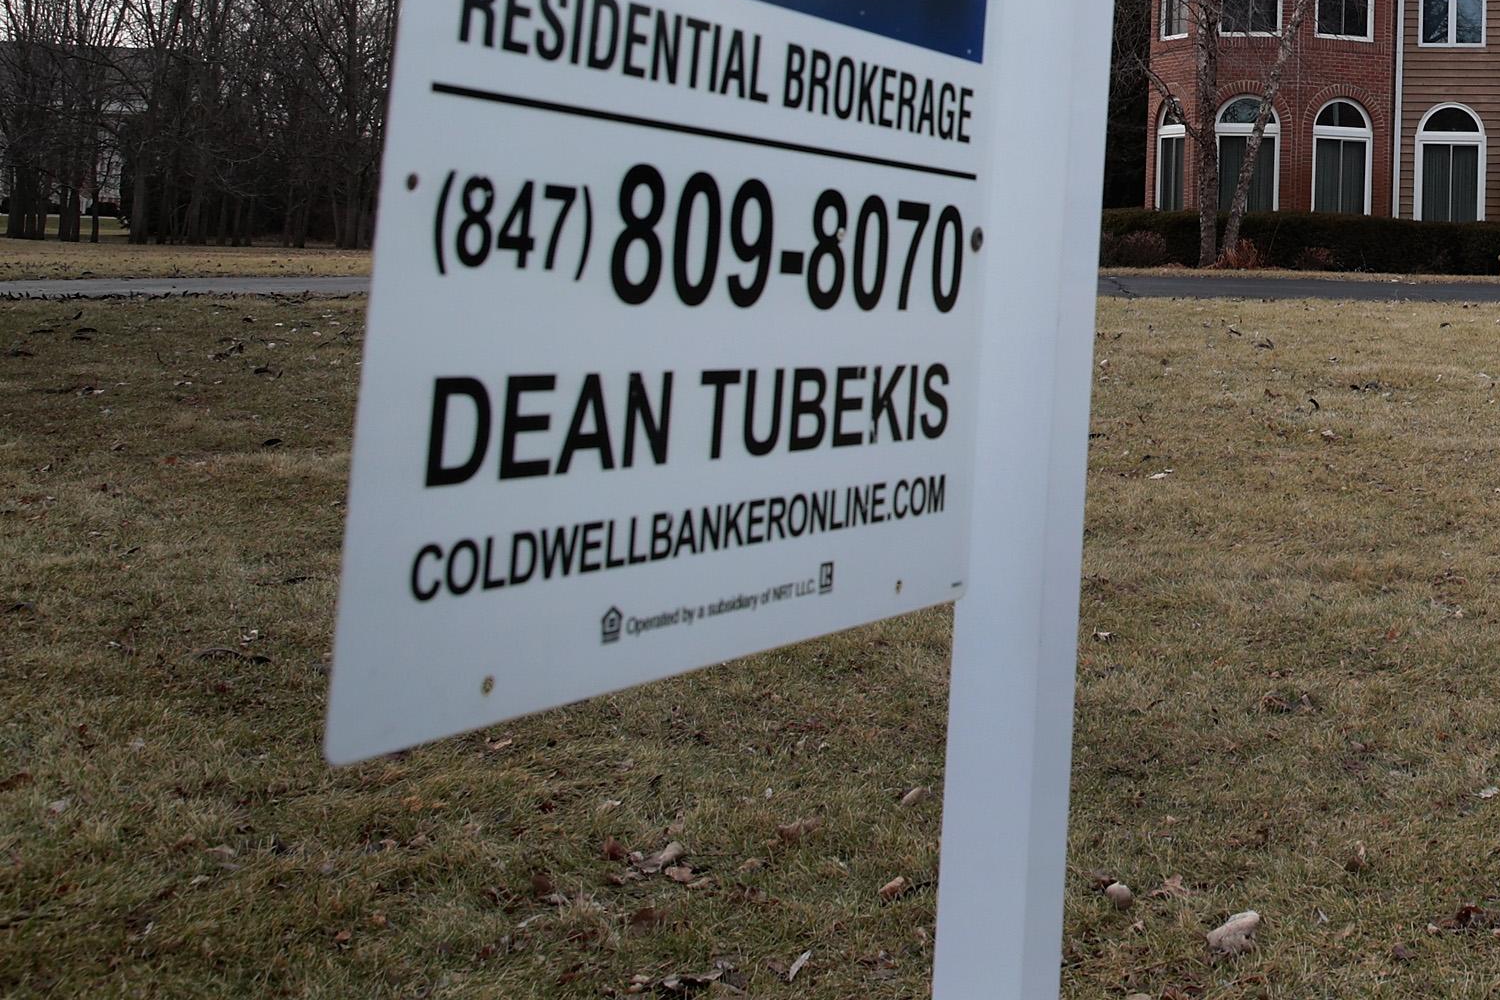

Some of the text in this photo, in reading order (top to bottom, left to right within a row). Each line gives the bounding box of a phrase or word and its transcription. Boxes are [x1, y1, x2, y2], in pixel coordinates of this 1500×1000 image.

[783, 44, 974, 144] BROKERAGE
[435, 164, 963, 313] (847) 809-8070
[425, 362, 950, 487] DEAN TUBEKIS
[412, 475, 945, 601] COLDWELLBANKERONLINE.COM
[626, 609, 679, 636] Operated
[681, 606, 695, 625] by
[697, 605, 704, 619] a
[707, 594, 757, 617] subsidiary
[761, 587, 771, 605] of
